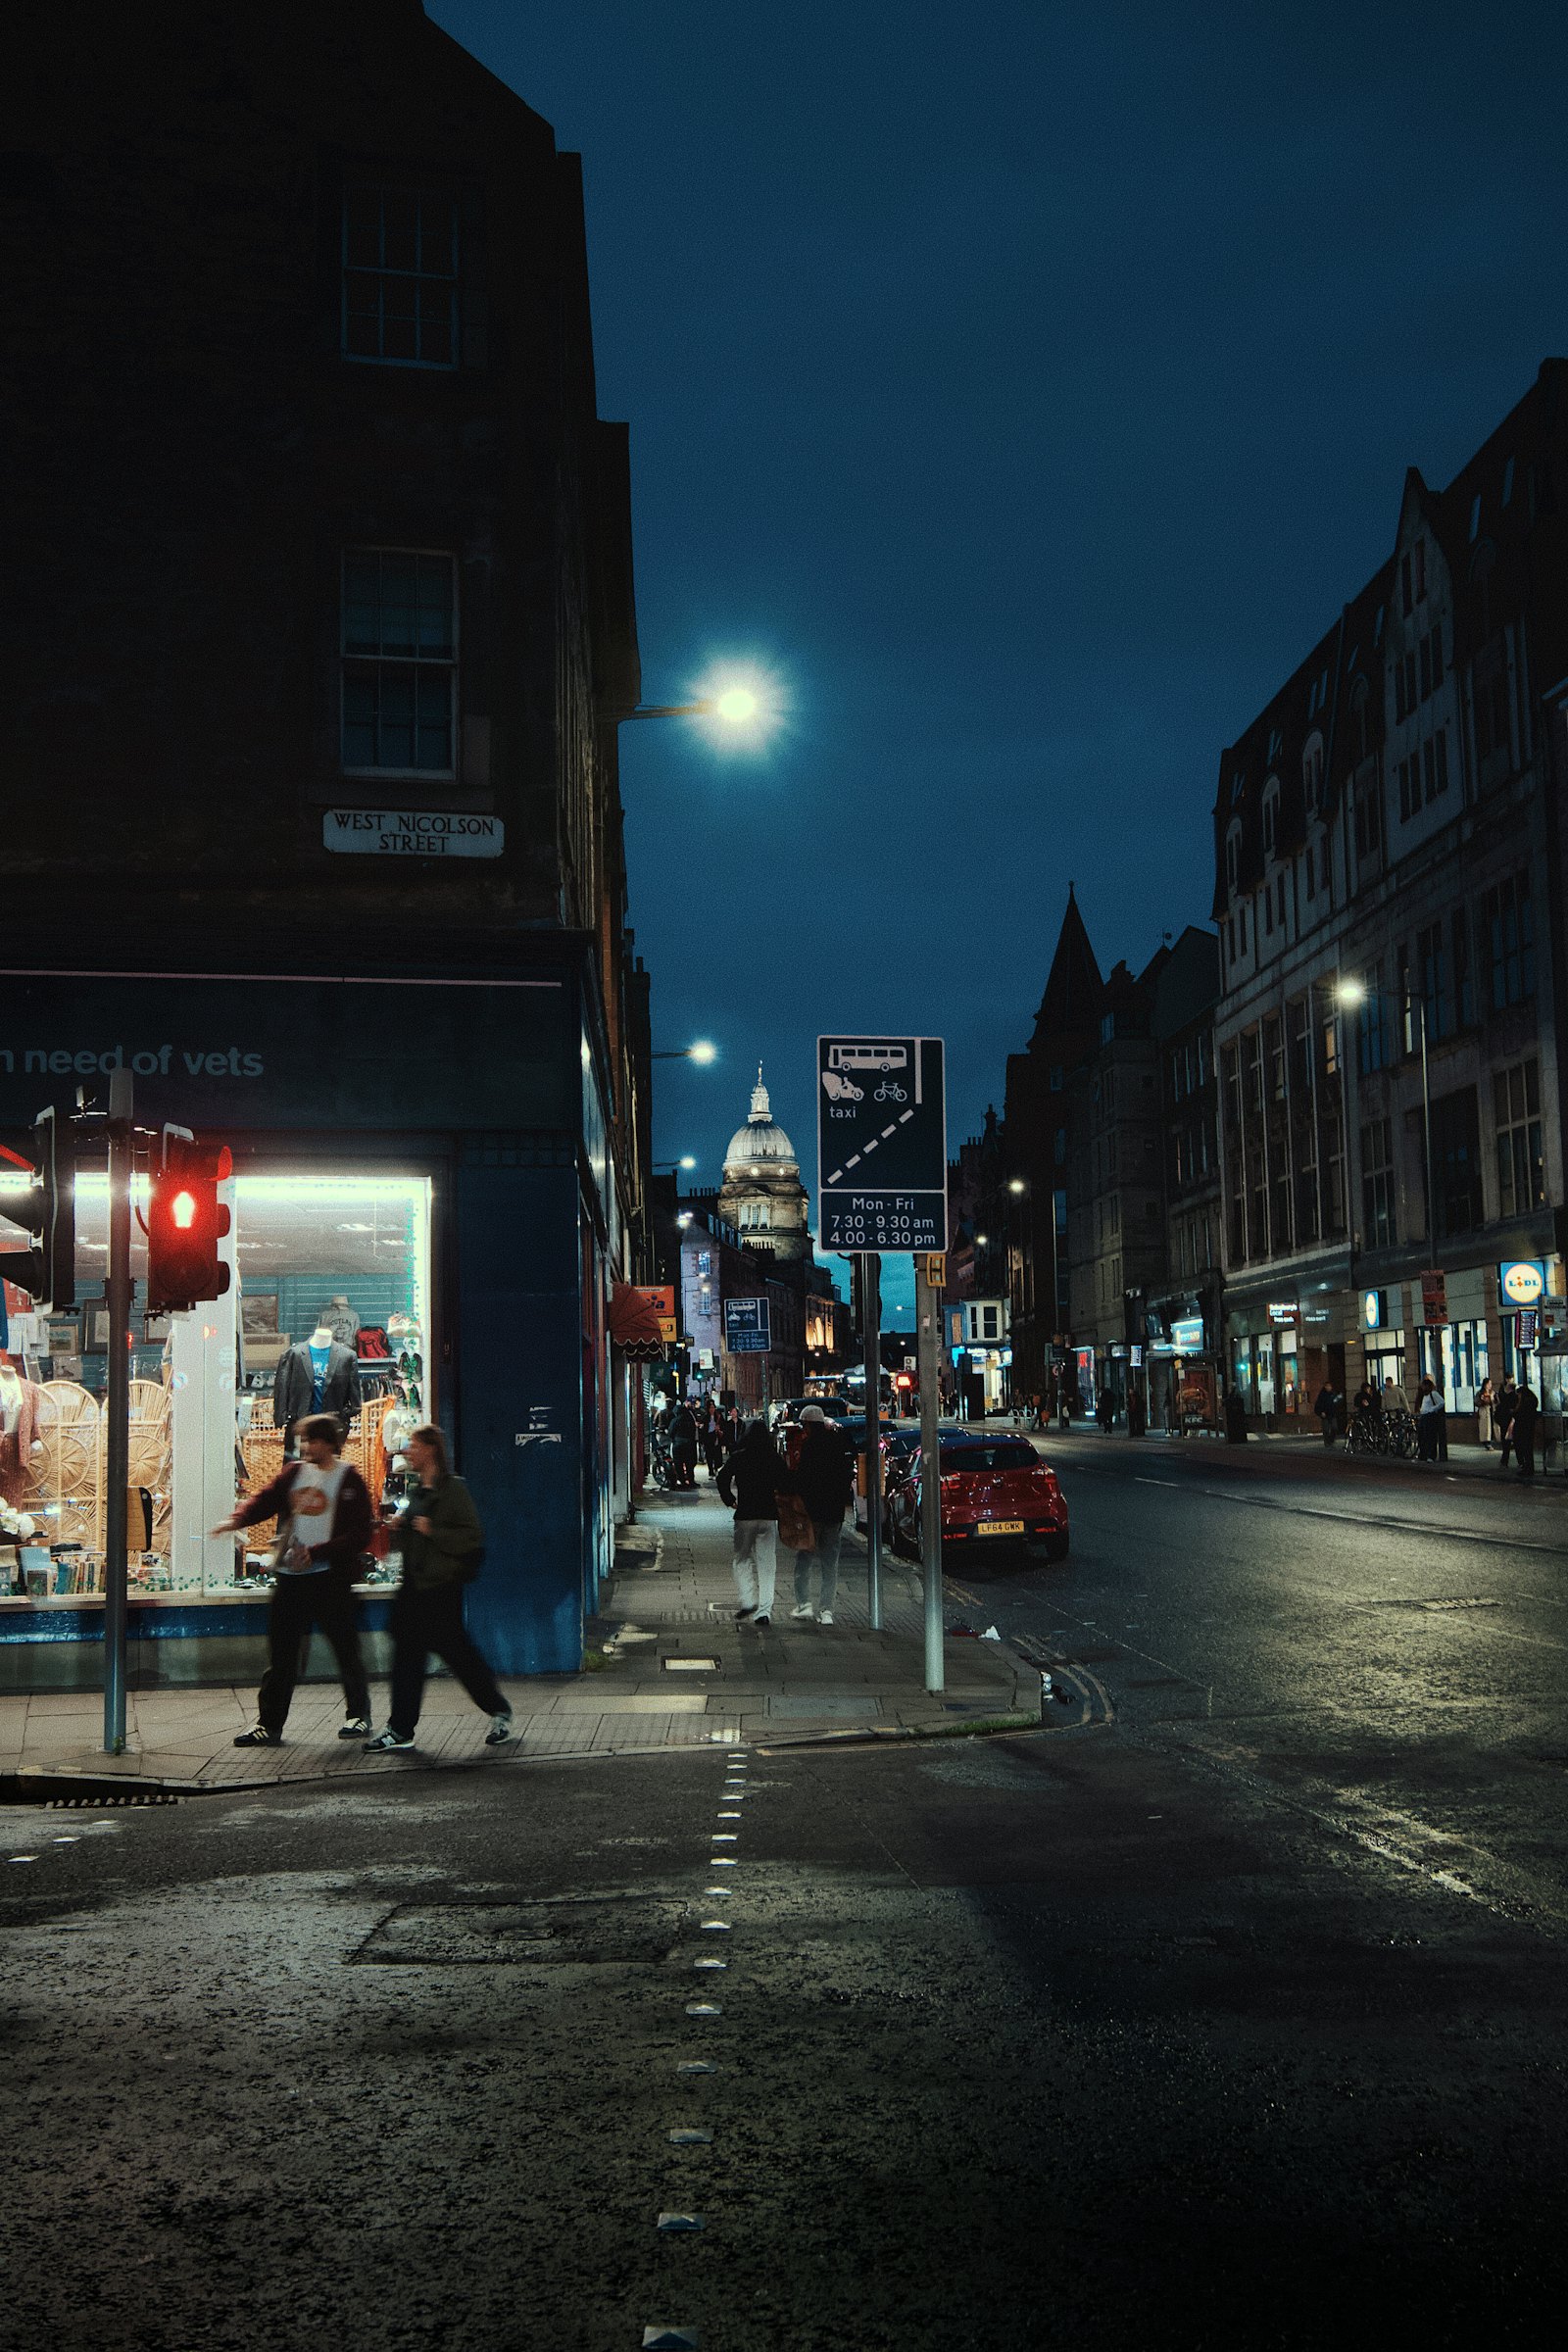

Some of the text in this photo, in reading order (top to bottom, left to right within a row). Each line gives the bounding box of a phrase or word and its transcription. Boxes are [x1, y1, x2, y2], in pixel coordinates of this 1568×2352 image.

[334, 812, 494, 836] WEST NICOLSON
[379, 834, 449, 853] STREET
[24, 1044, 123, 1075] need
[131, 1044, 173, 1076] of
[183, 1046, 265, 1077] vets
[829, 1105, 857, 1118] taxi
[852, 1197, 884, 1210] Mon
[896, 1198, 915, 1210] Fri
[831, 1215, 864, 1228] 7.30
[876, 1215, 910, 1229] 9.30
[913, 1218, 934, 1229] am
[830, 1231, 866, 1245] 4.00
[877, 1231, 911, 1245] 6.30
[914, 1234, 936, 1247] pm
[981, 1522, 1020, 1533] LF64 GWK
